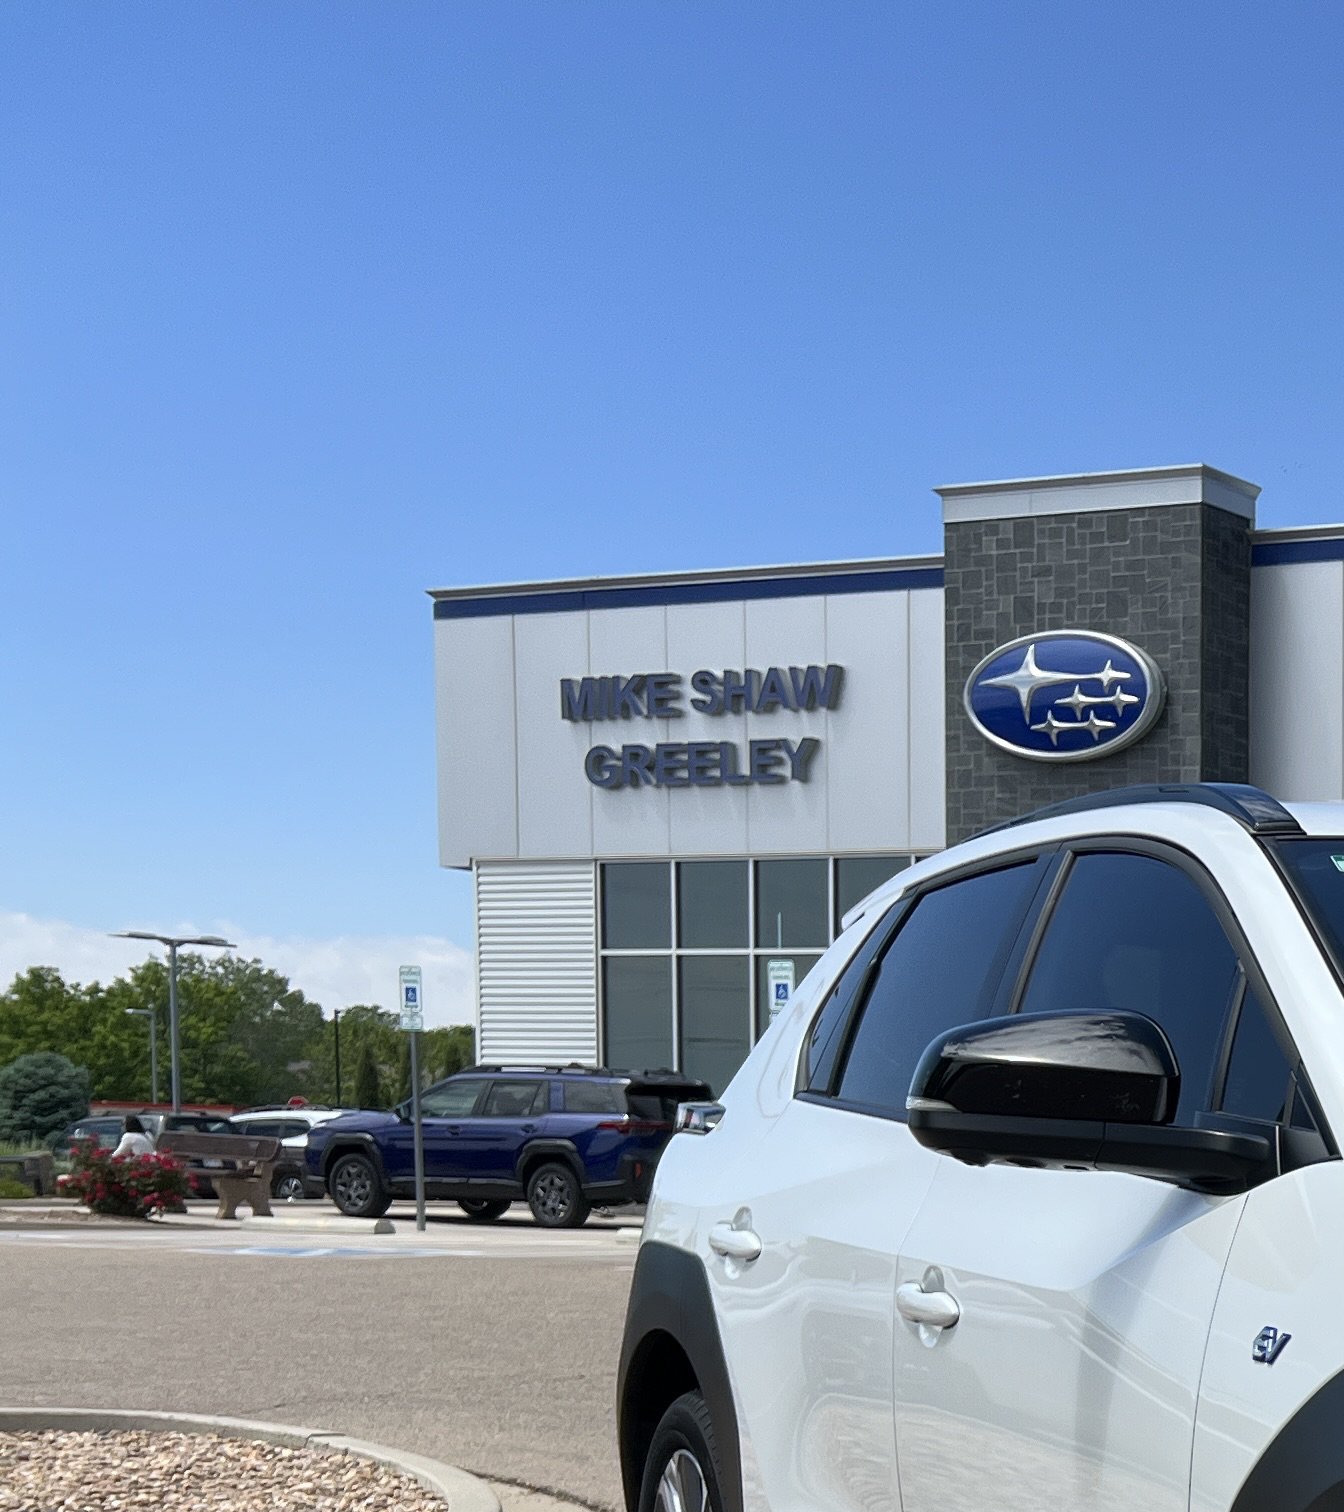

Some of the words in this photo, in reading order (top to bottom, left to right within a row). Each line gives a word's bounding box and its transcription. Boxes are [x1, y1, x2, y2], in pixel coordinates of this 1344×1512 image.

[560, 672, 685, 722] MIKE
[690, 664, 844, 716] SHAW
[584, 737, 820, 790] GREELEY
